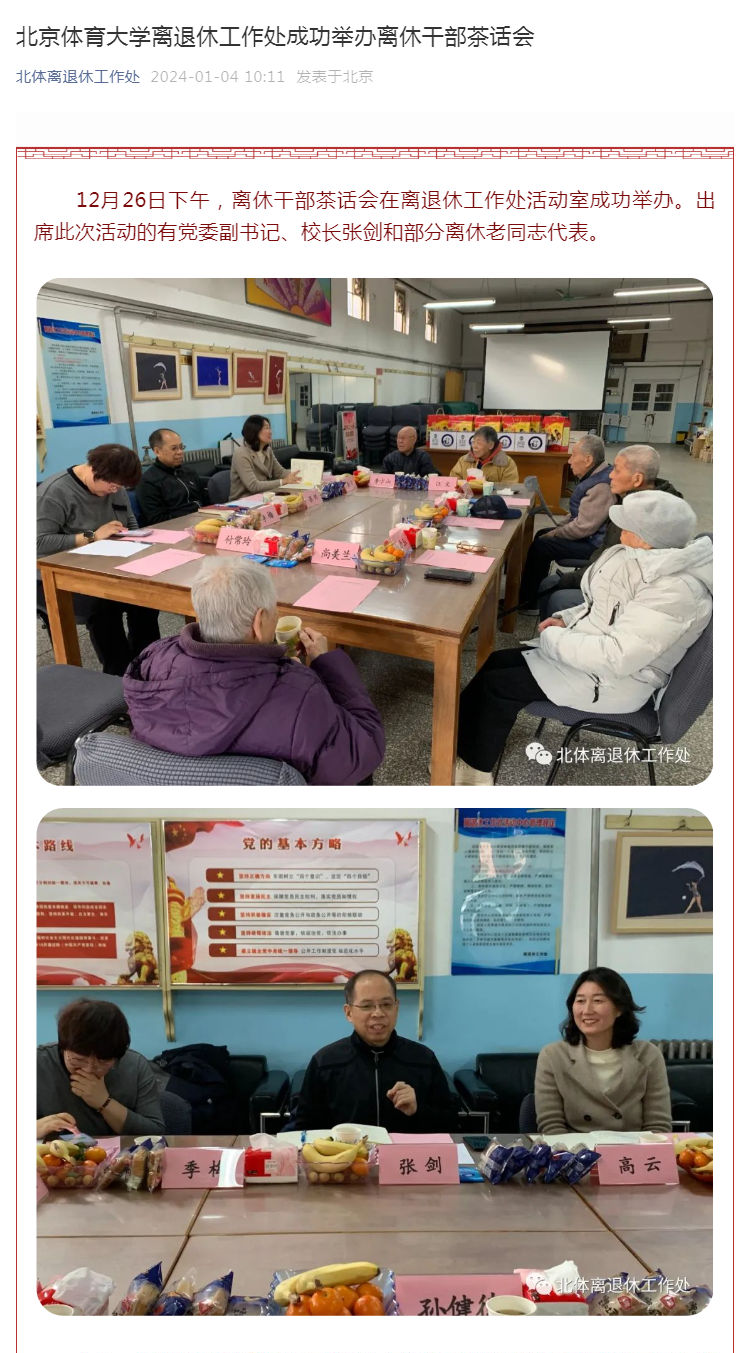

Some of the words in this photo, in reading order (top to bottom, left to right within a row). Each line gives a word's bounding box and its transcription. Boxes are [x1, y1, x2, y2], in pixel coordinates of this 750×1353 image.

[37, 839, 74, 852] 路线
[242, 837, 342, 850] 党的基本方略
[399, 1157, 443, 1175] 张剑
[618, 1156, 662, 1174] 高云
